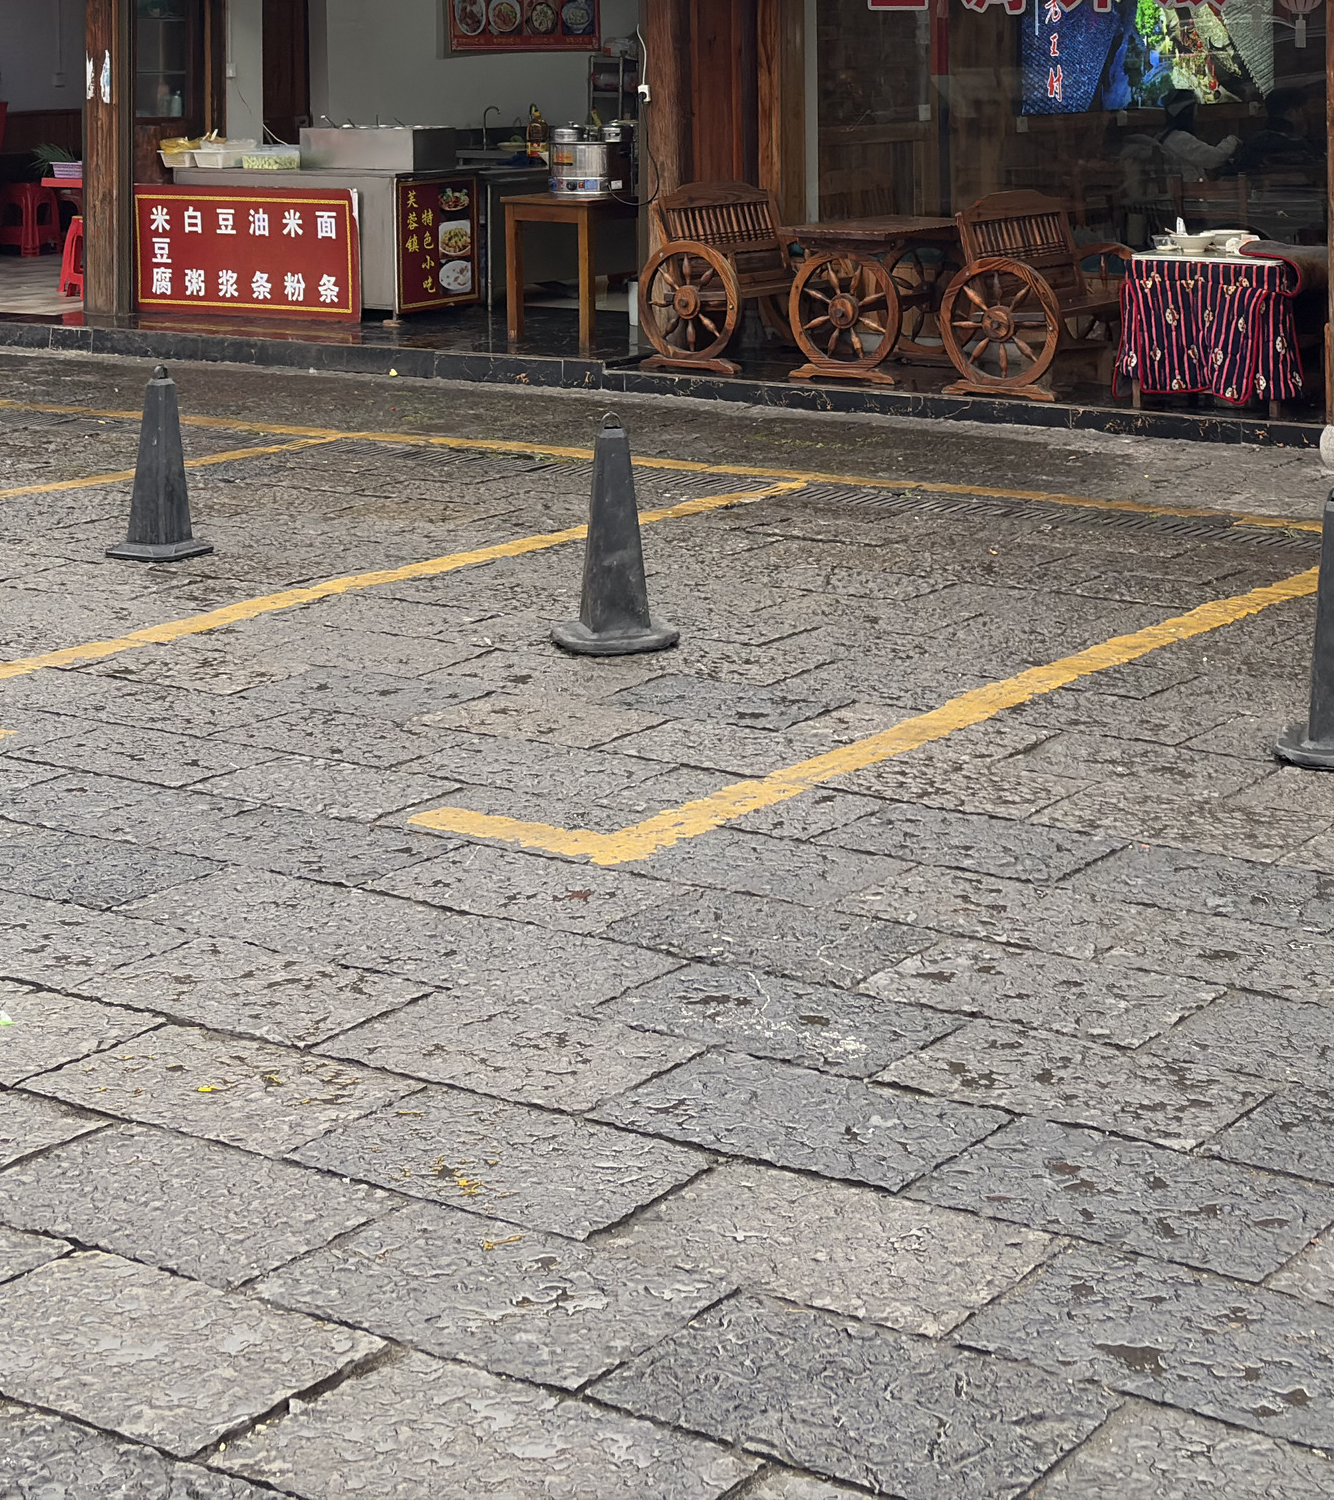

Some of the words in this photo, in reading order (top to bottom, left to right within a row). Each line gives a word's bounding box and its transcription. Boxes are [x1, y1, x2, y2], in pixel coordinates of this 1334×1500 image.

[150, 205, 172, 296] 米豆腐
[183, 206, 205, 297] 白粥
[216, 208, 239, 298] 豆浆
[249, 208, 272, 300] 油条
[282, 209, 306, 302] 米粉
[316, 211, 340, 304] 面条
[405, 189, 420, 253] 芙蓉镇
[421, 208, 436, 293] 特色小吃
